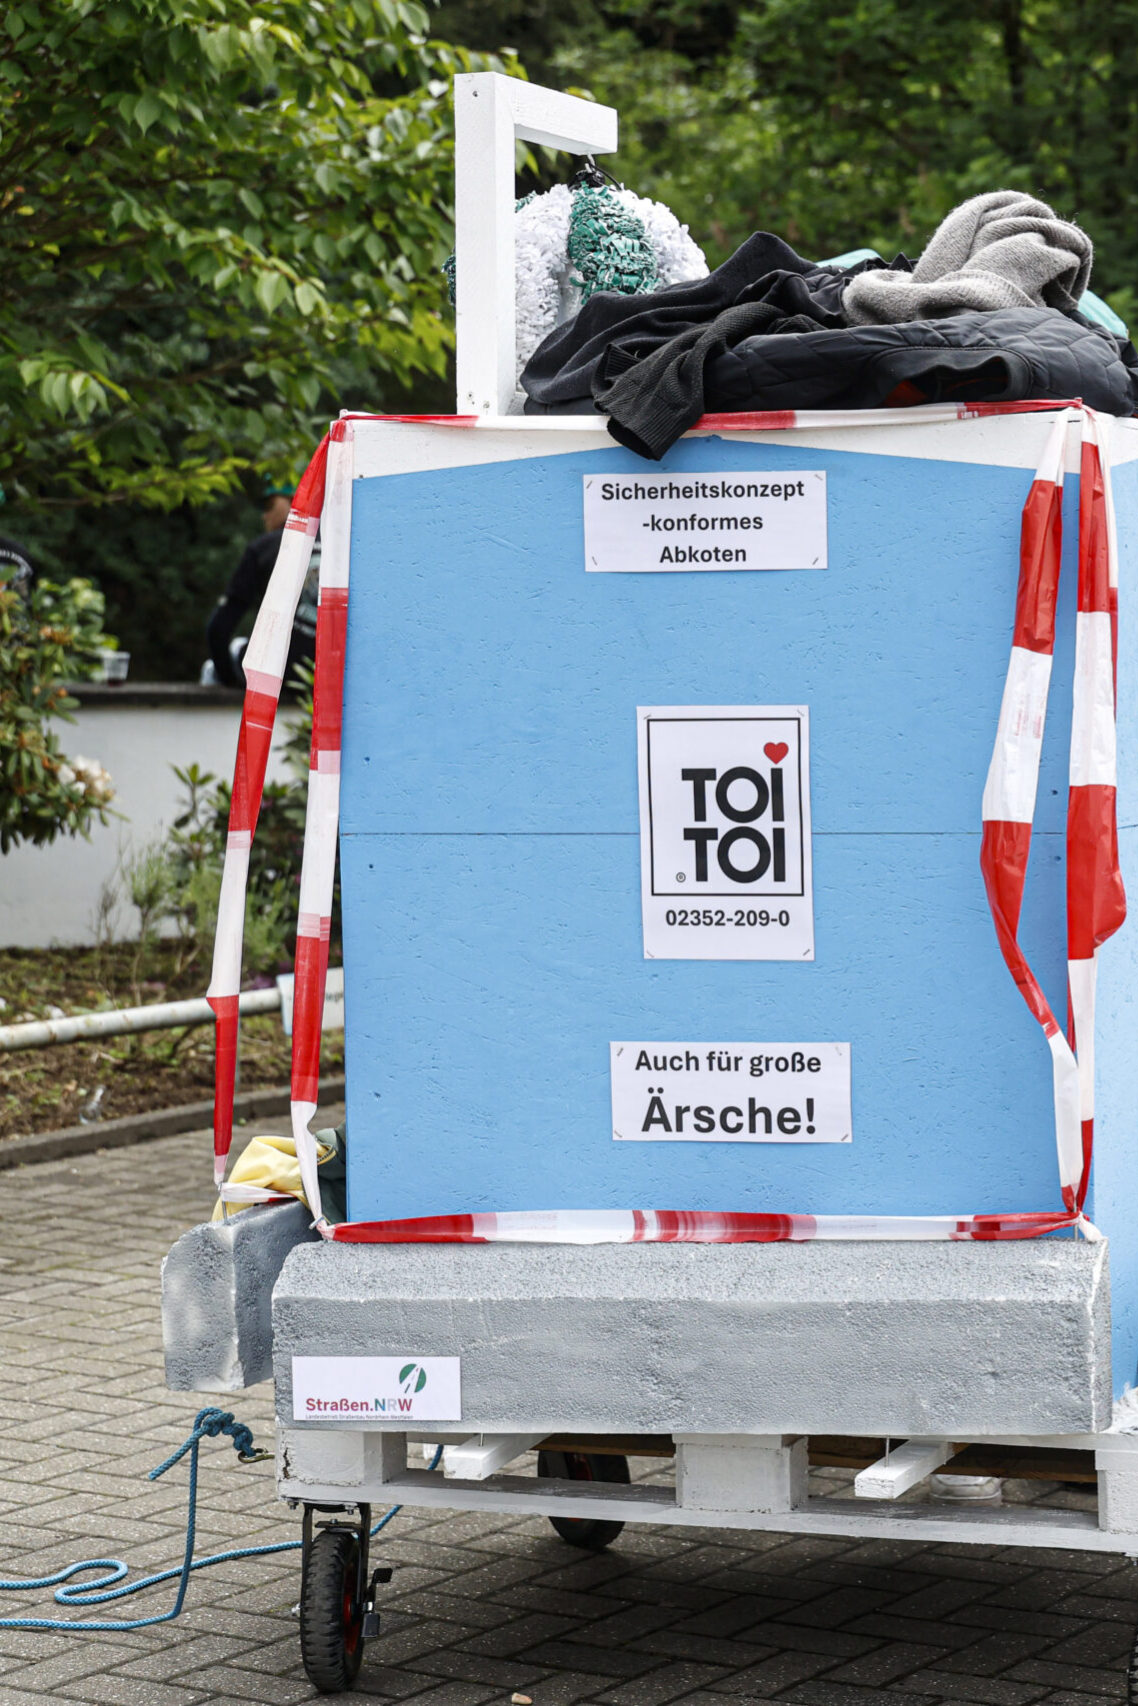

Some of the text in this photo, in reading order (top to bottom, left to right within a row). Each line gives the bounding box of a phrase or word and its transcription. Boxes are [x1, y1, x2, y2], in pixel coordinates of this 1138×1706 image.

[601, 480, 805, 501] Sicherheitskonzept
[643, 514, 763, 532] -konformes
[659, 546, 747, 564] Abkoten
[683, 826, 786, 884] TOI
[665, 909, 790, 928] 02352-209-0
[635, 1050, 822, 1077] Auch für große
[641, 1087, 816, 1135] Ärsche!
[305, 1398, 413, 1412] Straßen.NRW
